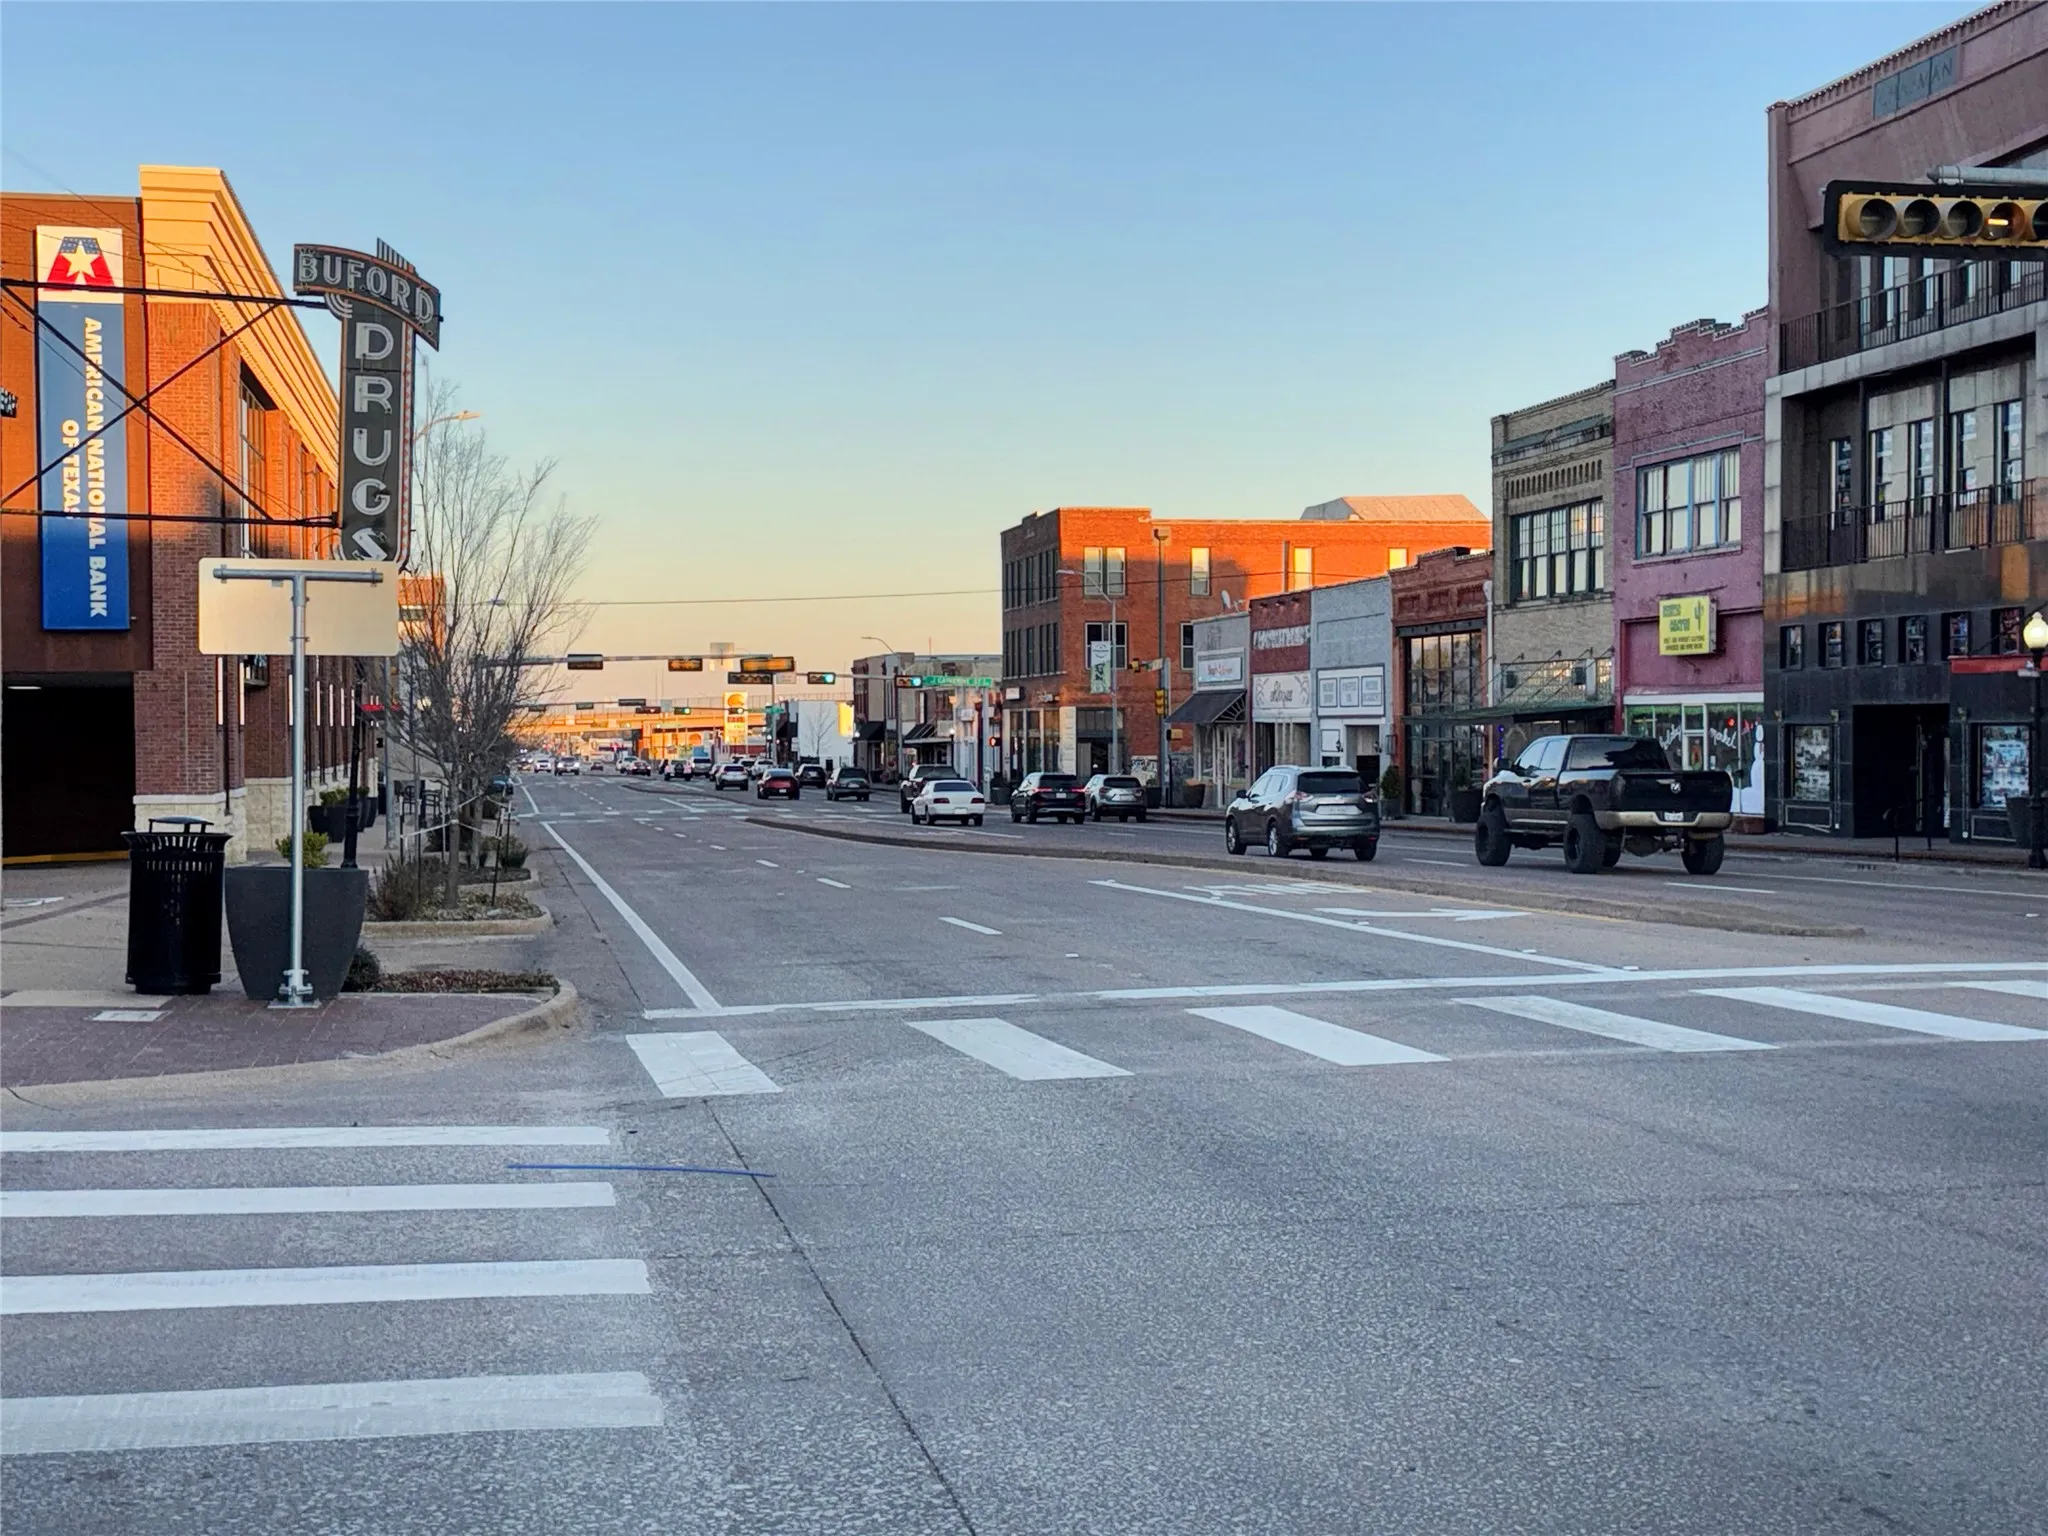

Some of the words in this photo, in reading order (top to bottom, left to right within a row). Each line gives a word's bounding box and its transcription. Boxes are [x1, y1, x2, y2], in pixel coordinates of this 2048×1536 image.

[298, 250, 434, 324] BUFORD
[84, 316, 104, 431] AMERICAN
[61, 419, 80, 449] OF
[351, 322, 394, 562] DRUGS
[87, 438, 106, 549] NATIONAL
[89, 556, 108, 618] BANK
